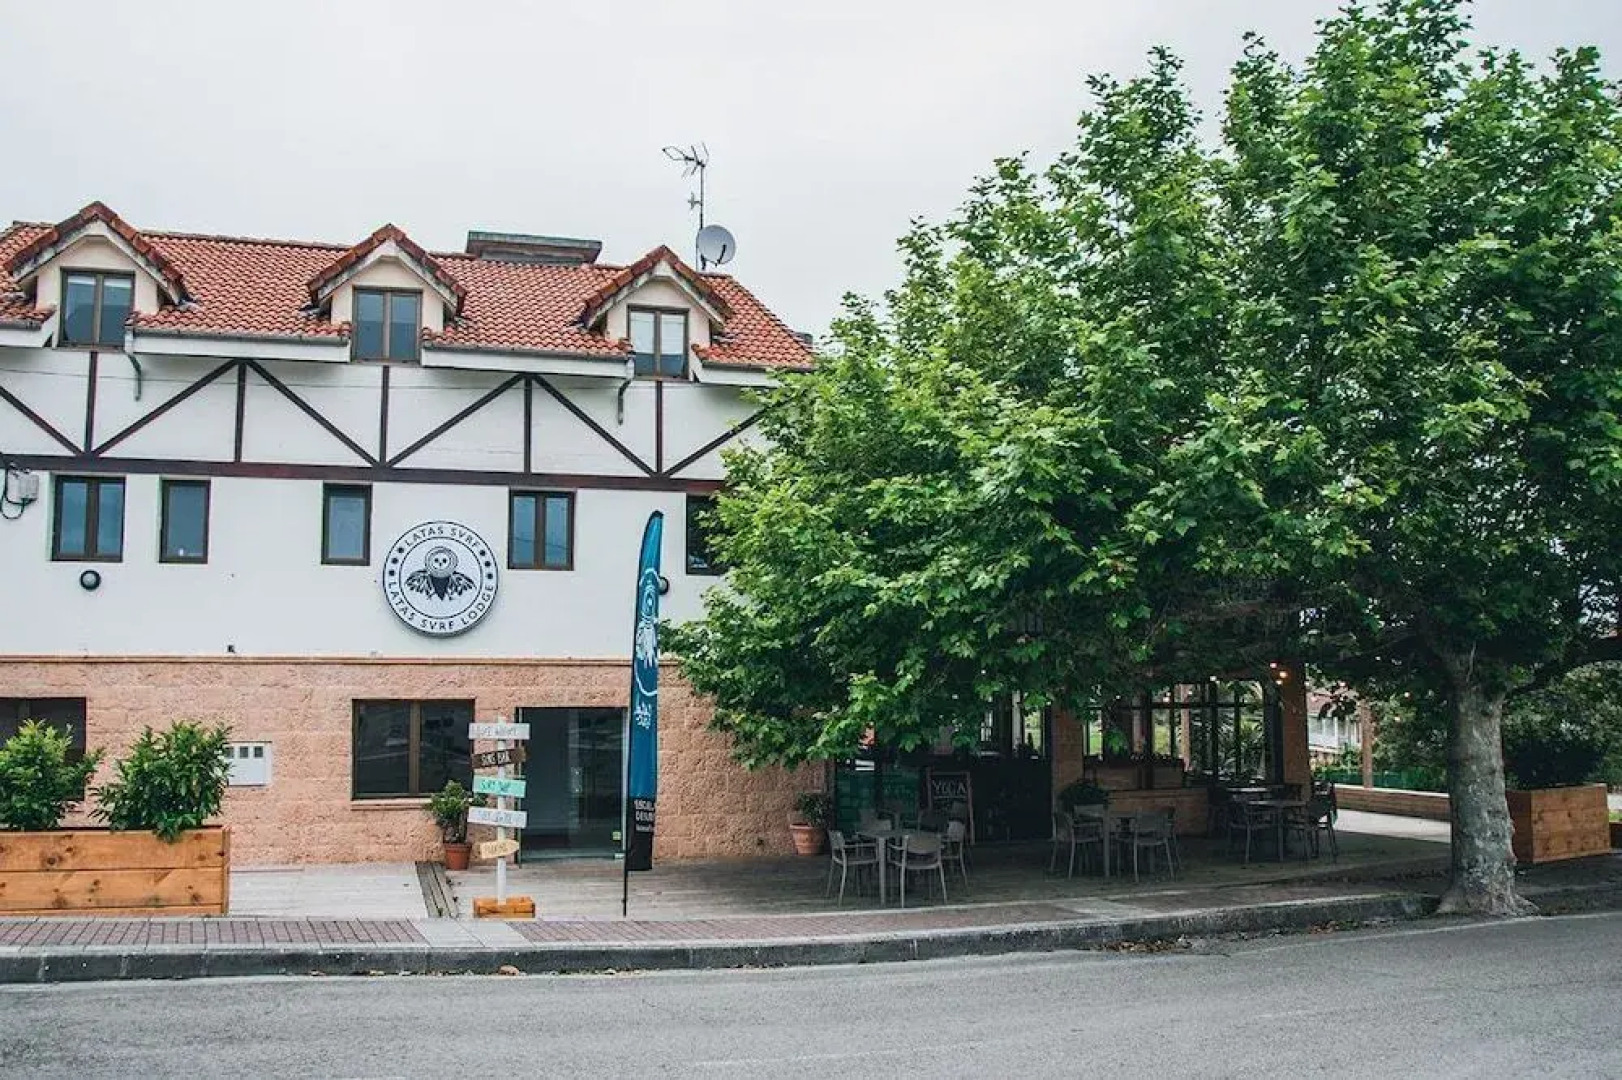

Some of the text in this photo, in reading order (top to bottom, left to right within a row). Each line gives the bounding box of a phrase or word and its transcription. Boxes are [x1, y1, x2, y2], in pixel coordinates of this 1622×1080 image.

[405, 526, 444, 547] LATAS
[388, 581, 417, 620] LATAS
[460, 585, 494, 625] LODGE
